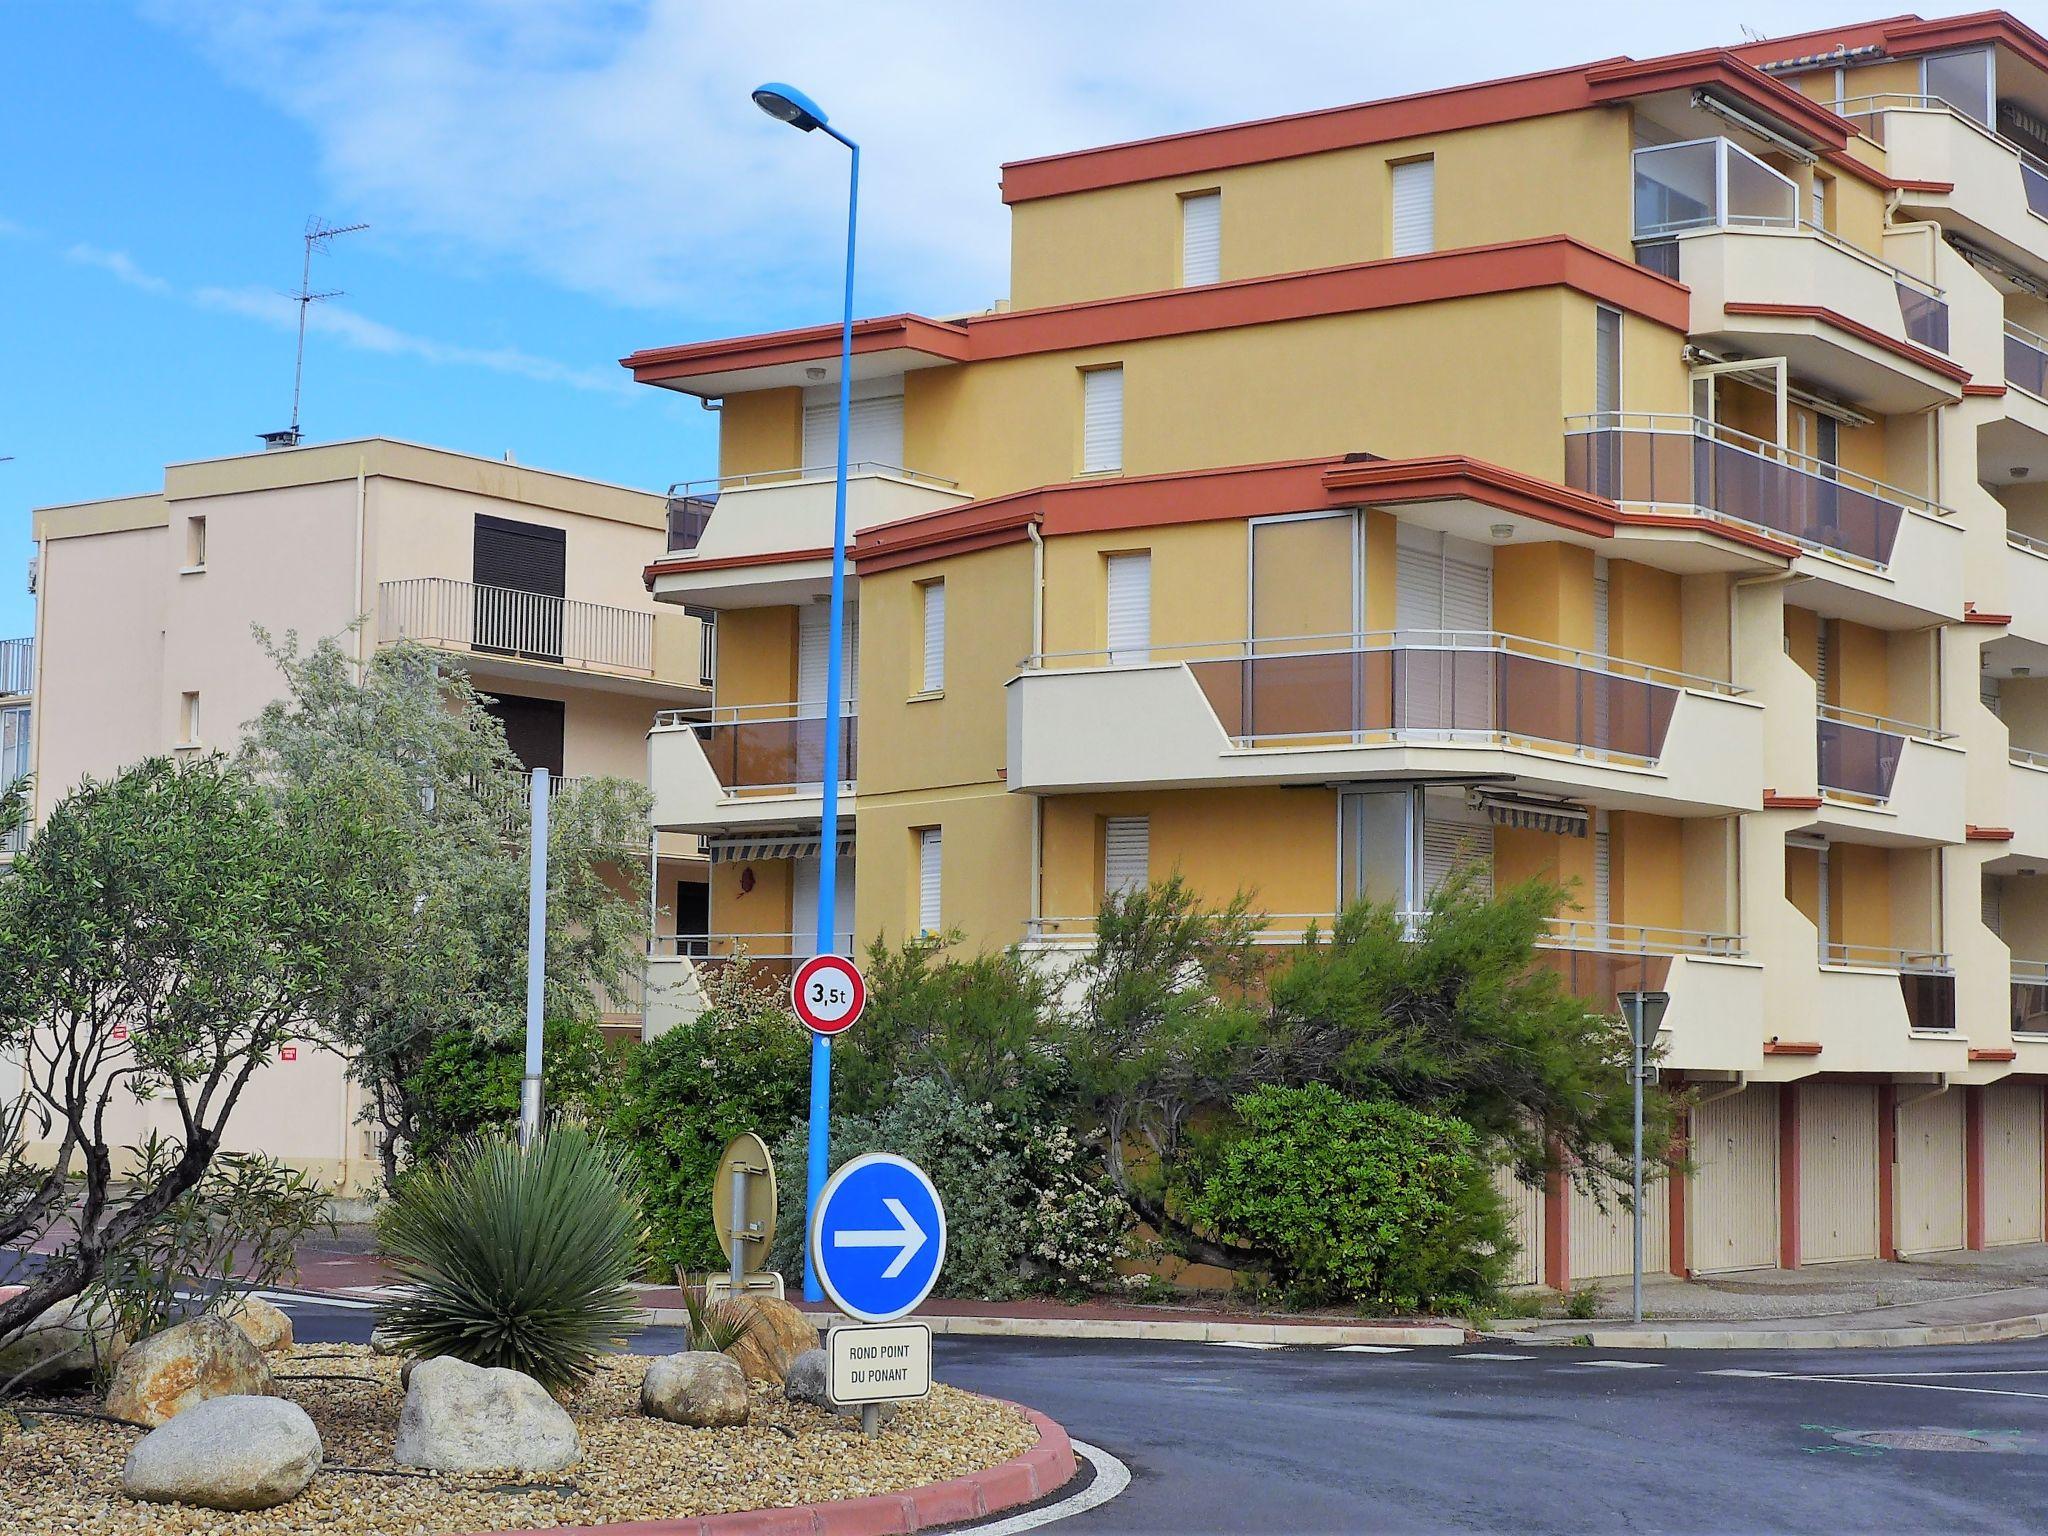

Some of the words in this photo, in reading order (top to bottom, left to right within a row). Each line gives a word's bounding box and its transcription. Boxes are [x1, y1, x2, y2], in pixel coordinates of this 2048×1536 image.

[812, 983, 846, 1006] 3,5t
[850, 1346, 877, 1360] ROND
[881, 1345, 910, 1358] POINT
[851, 1370, 865, 1383] DU
[868, 1368, 908, 1382] PONANT
